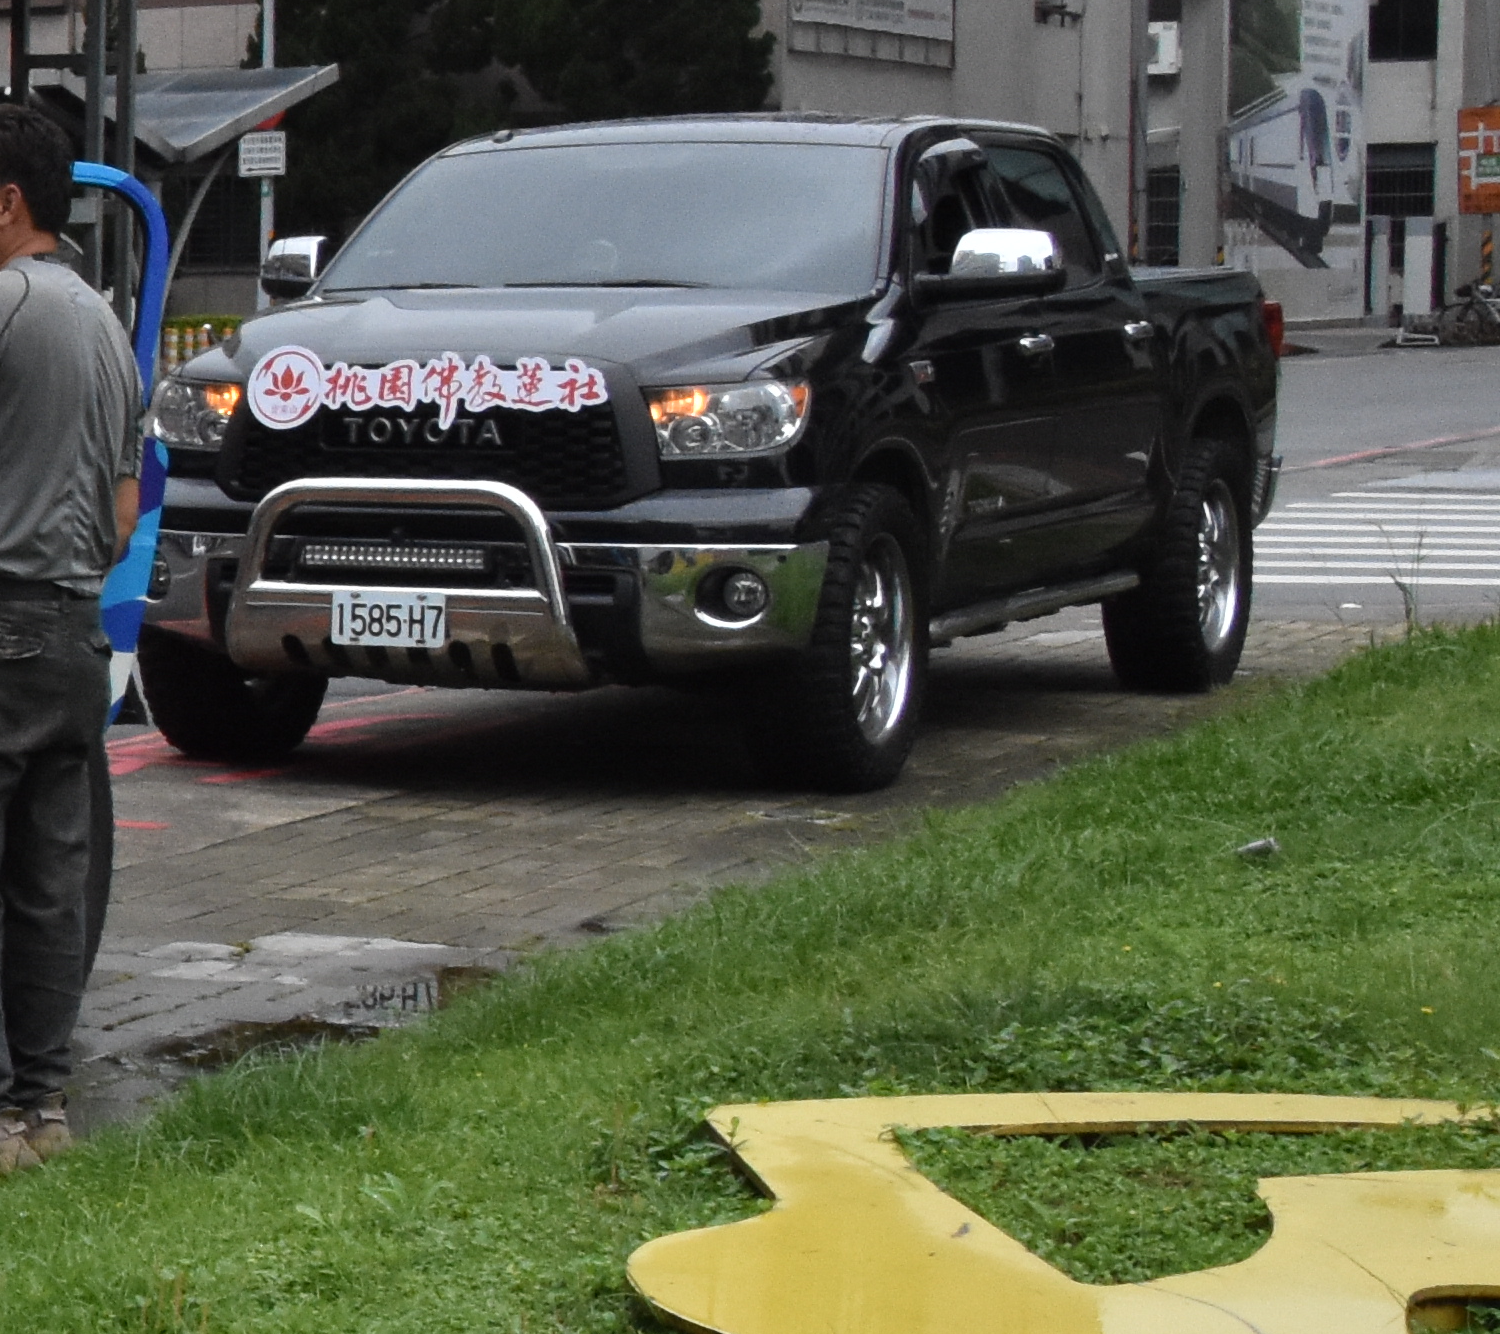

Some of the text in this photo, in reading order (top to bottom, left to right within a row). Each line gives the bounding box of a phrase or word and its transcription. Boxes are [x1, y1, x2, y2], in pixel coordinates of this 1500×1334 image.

[323, 357, 602, 424] 桃園佛教蓮社
[337, 602, 443, 641] 1585-H7
